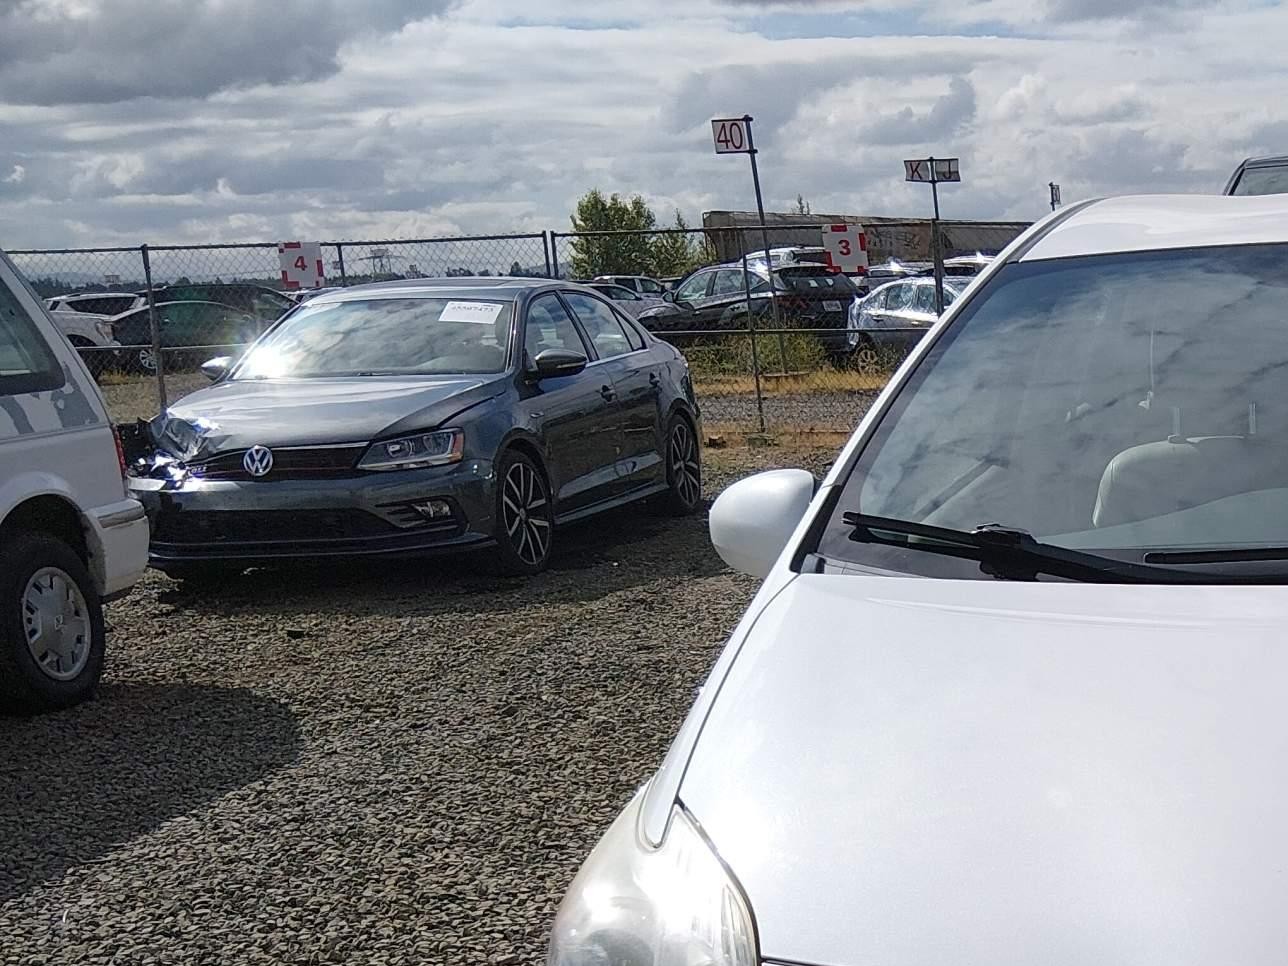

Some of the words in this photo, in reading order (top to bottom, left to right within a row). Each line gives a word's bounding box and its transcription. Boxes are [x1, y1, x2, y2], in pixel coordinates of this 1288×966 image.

[717, 122, 743, 150] 40
[909, 162, 922, 180] K
[838, 239, 851, 256] 3
[294, 255, 308, 271] 4
